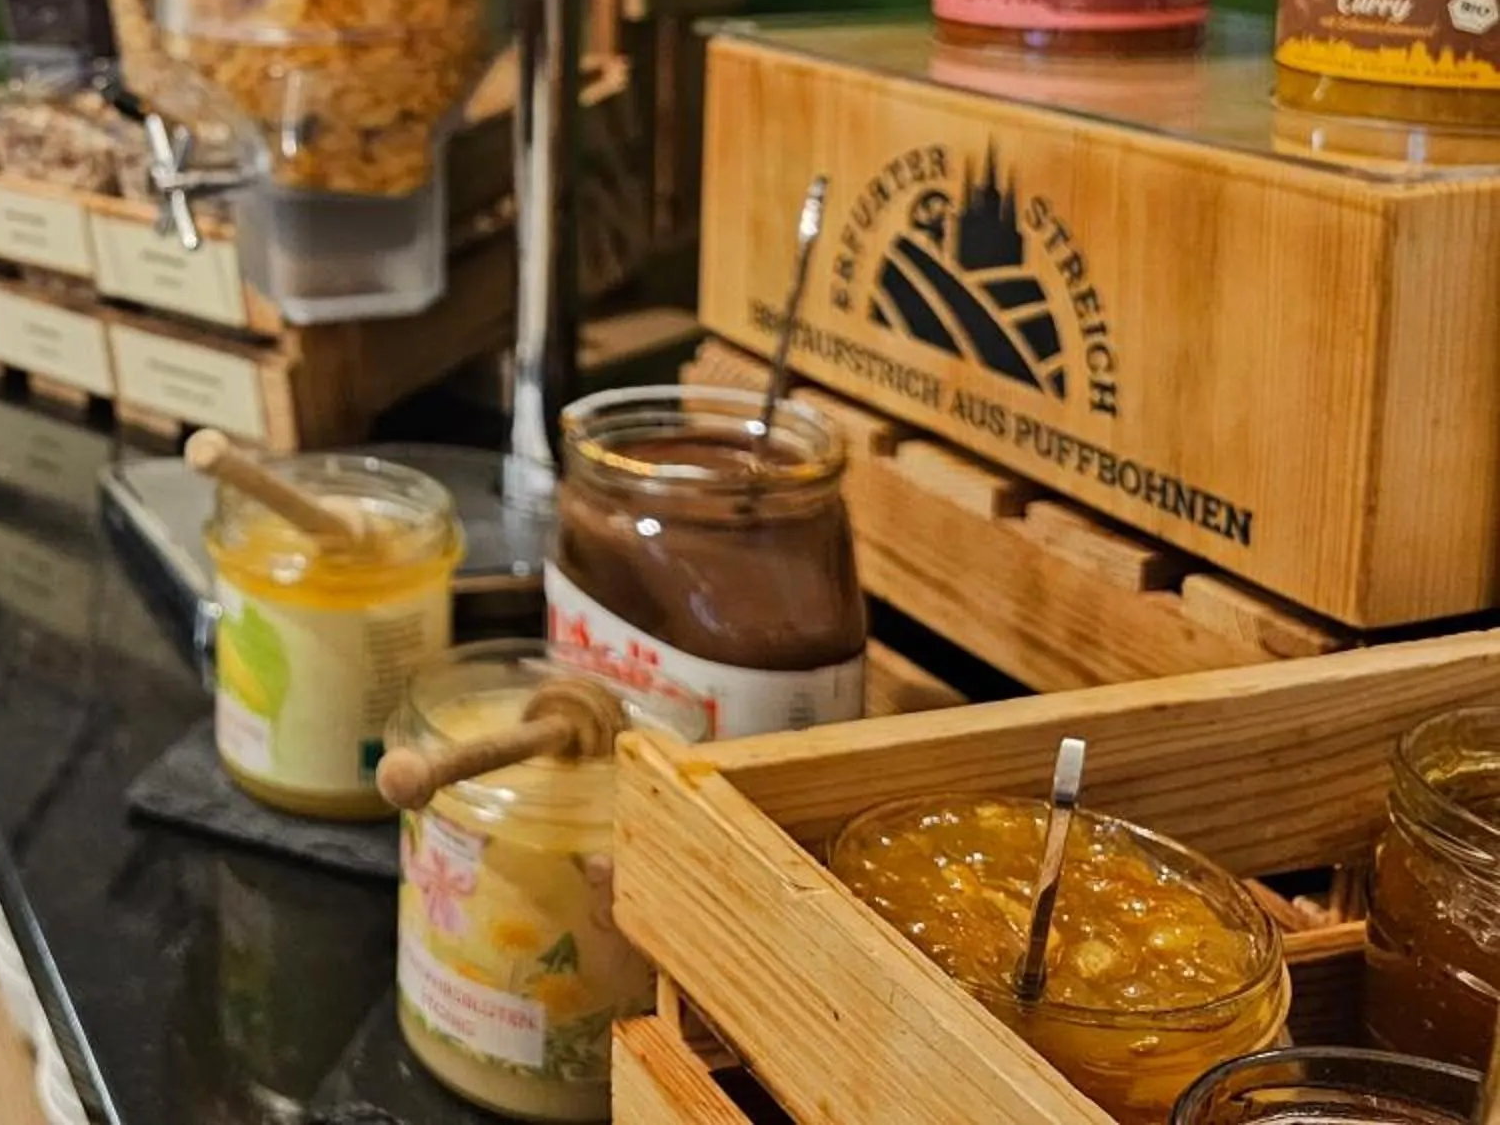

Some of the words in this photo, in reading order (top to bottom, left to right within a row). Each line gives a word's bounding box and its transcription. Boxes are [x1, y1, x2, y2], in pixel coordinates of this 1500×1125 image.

[831, 144, 948, 312] ERFURTER
[1026, 195, 1119, 418] STREICH
[751, 299, 941, 406] BRTAUFSTRICH
[950, 389, 1007, 434] AUS
[1013, 415, 1253, 547] PUFFBOHNEN
